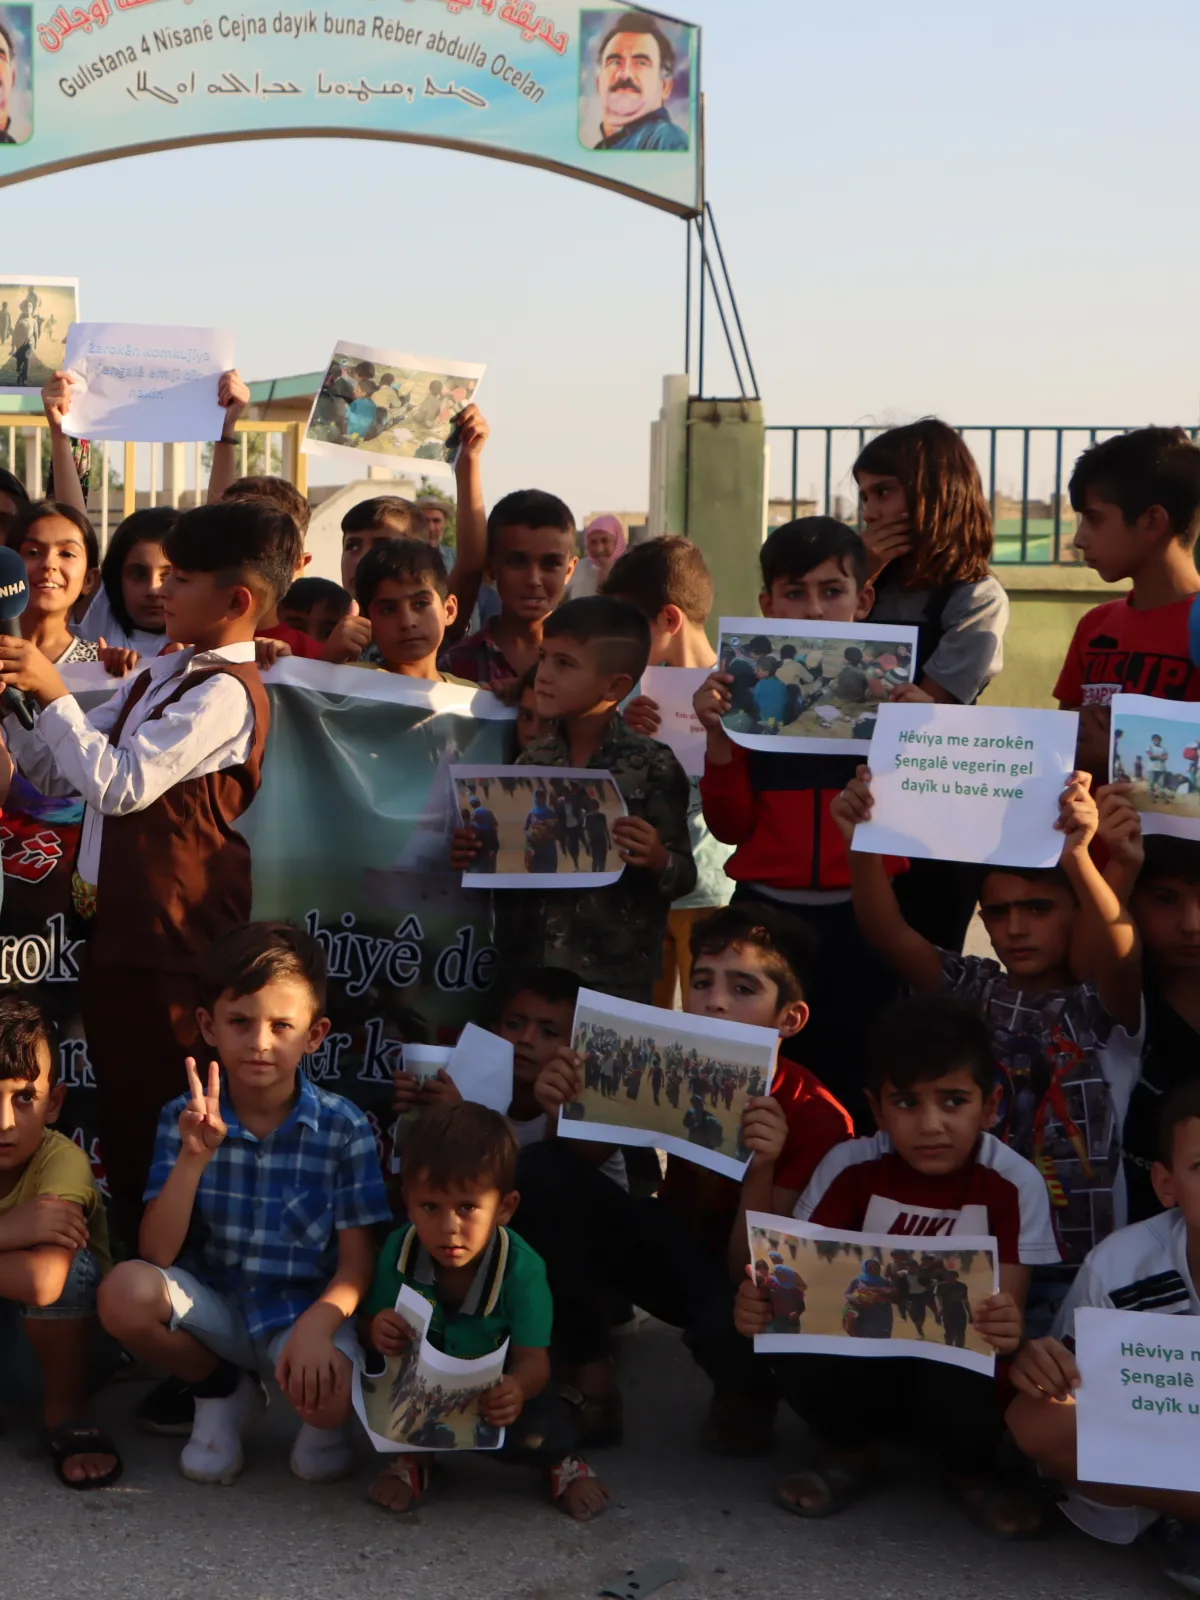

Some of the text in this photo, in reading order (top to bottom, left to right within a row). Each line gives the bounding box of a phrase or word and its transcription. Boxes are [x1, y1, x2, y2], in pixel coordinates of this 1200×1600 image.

[59, 45, 137, 97] Gulistana
[141, 34, 150, 55] 4
[219, 13, 266, 42] Cejna
[324, 10, 366, 36] buna
[426, 30, 487, 68] abdulla
[491, 53, 545, 103] Ocelan
[899, 731, 1034, 750] Hêviya me zarokên
[894, 754, 1033, 777] Şengalê vegerin gel
[901, 778, 1024, 799] dayîk u bavê xwe
[1120, 1342, 1184, 1363] Hêviya
[1120, 1368, 1194, 1388] Şengalê
[1131, 1396, 1200, 1415] dayîk u
